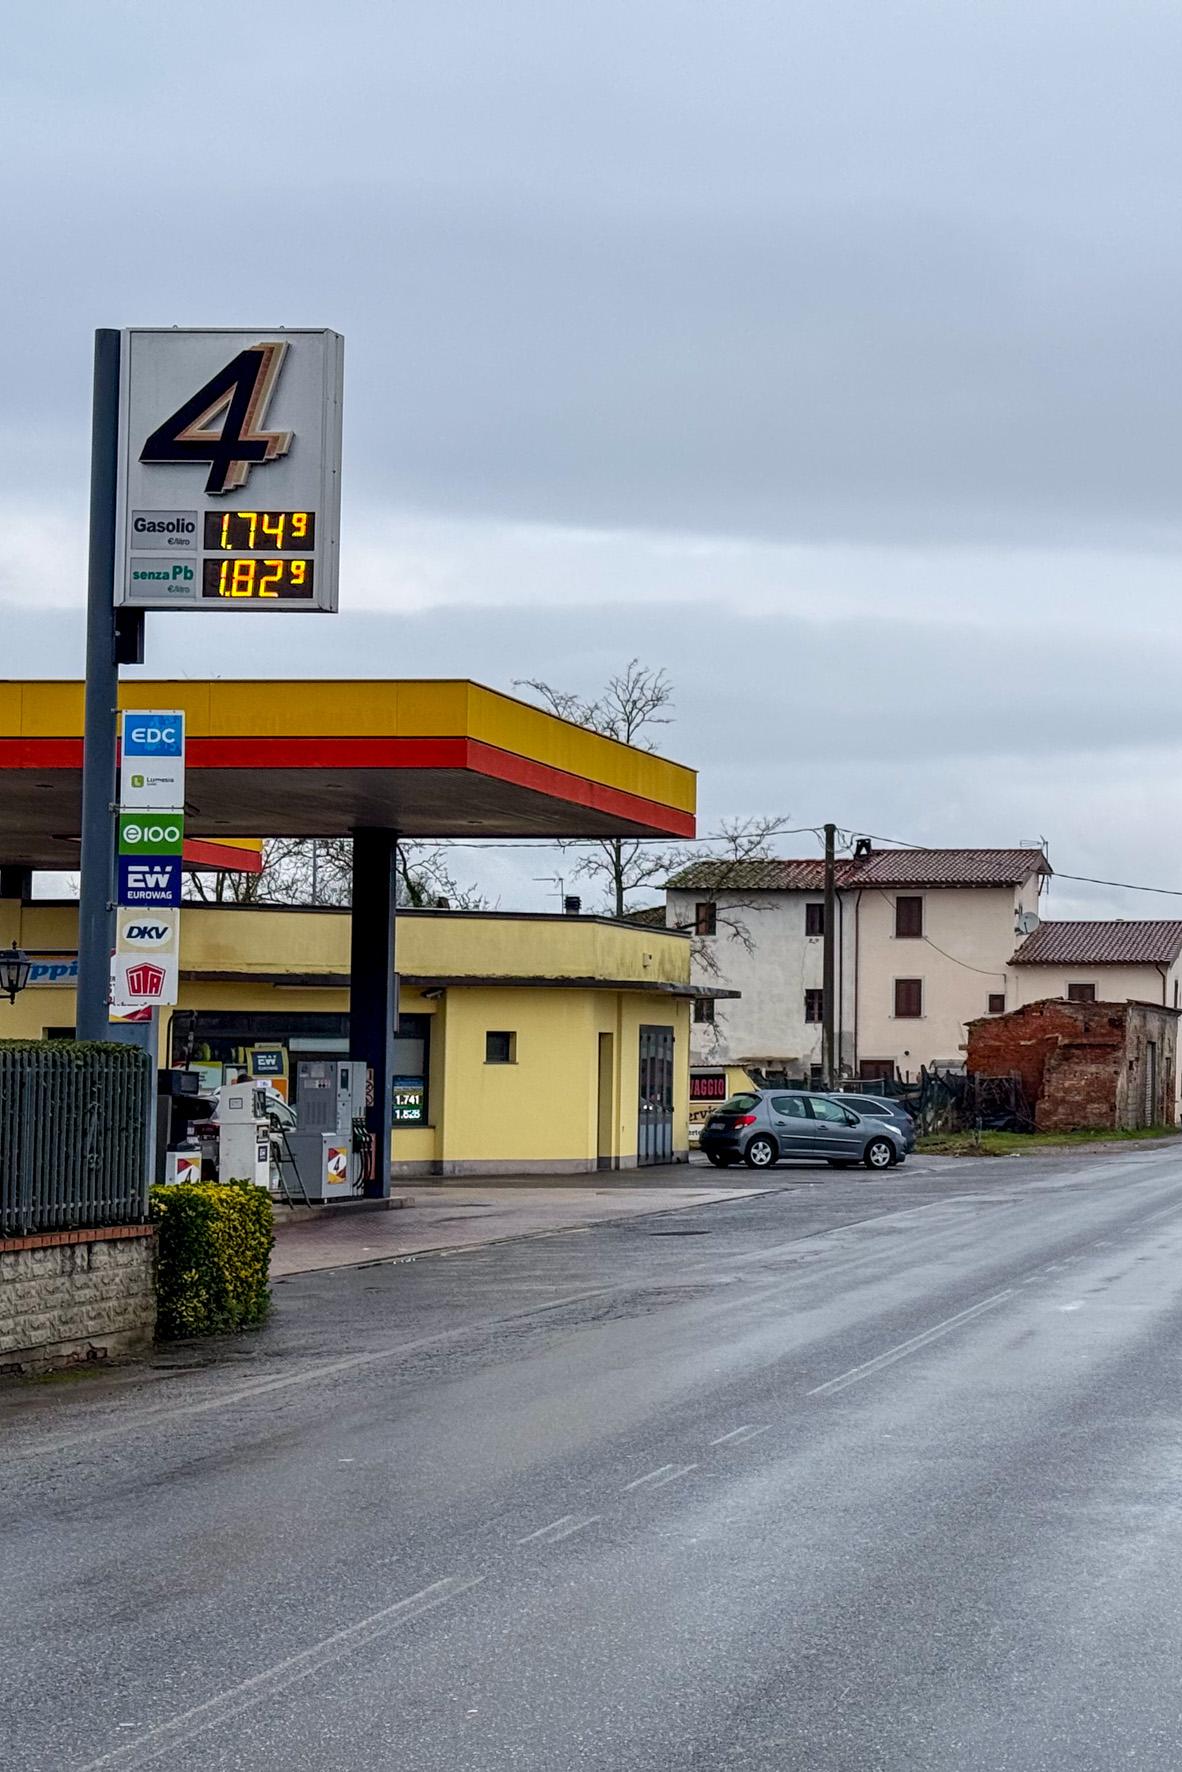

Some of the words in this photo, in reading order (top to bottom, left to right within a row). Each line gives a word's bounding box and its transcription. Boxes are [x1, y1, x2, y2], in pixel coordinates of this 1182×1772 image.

[138, 340, 295, 496] 4
[133, 517, 196, 534] Gasolio
[132, 570, 170, 581] senza
[171, 565, 194, 581] Pb
[131, 727, 176, 743] EDC
[127, 865, 173, 888] EW
[127, 891, 173, 900] EUROWAG
[126, 926, 169, 939] DKV
[129, 965, 163, 994] UTA
[395, 1094, 420, 1105] 1.741
